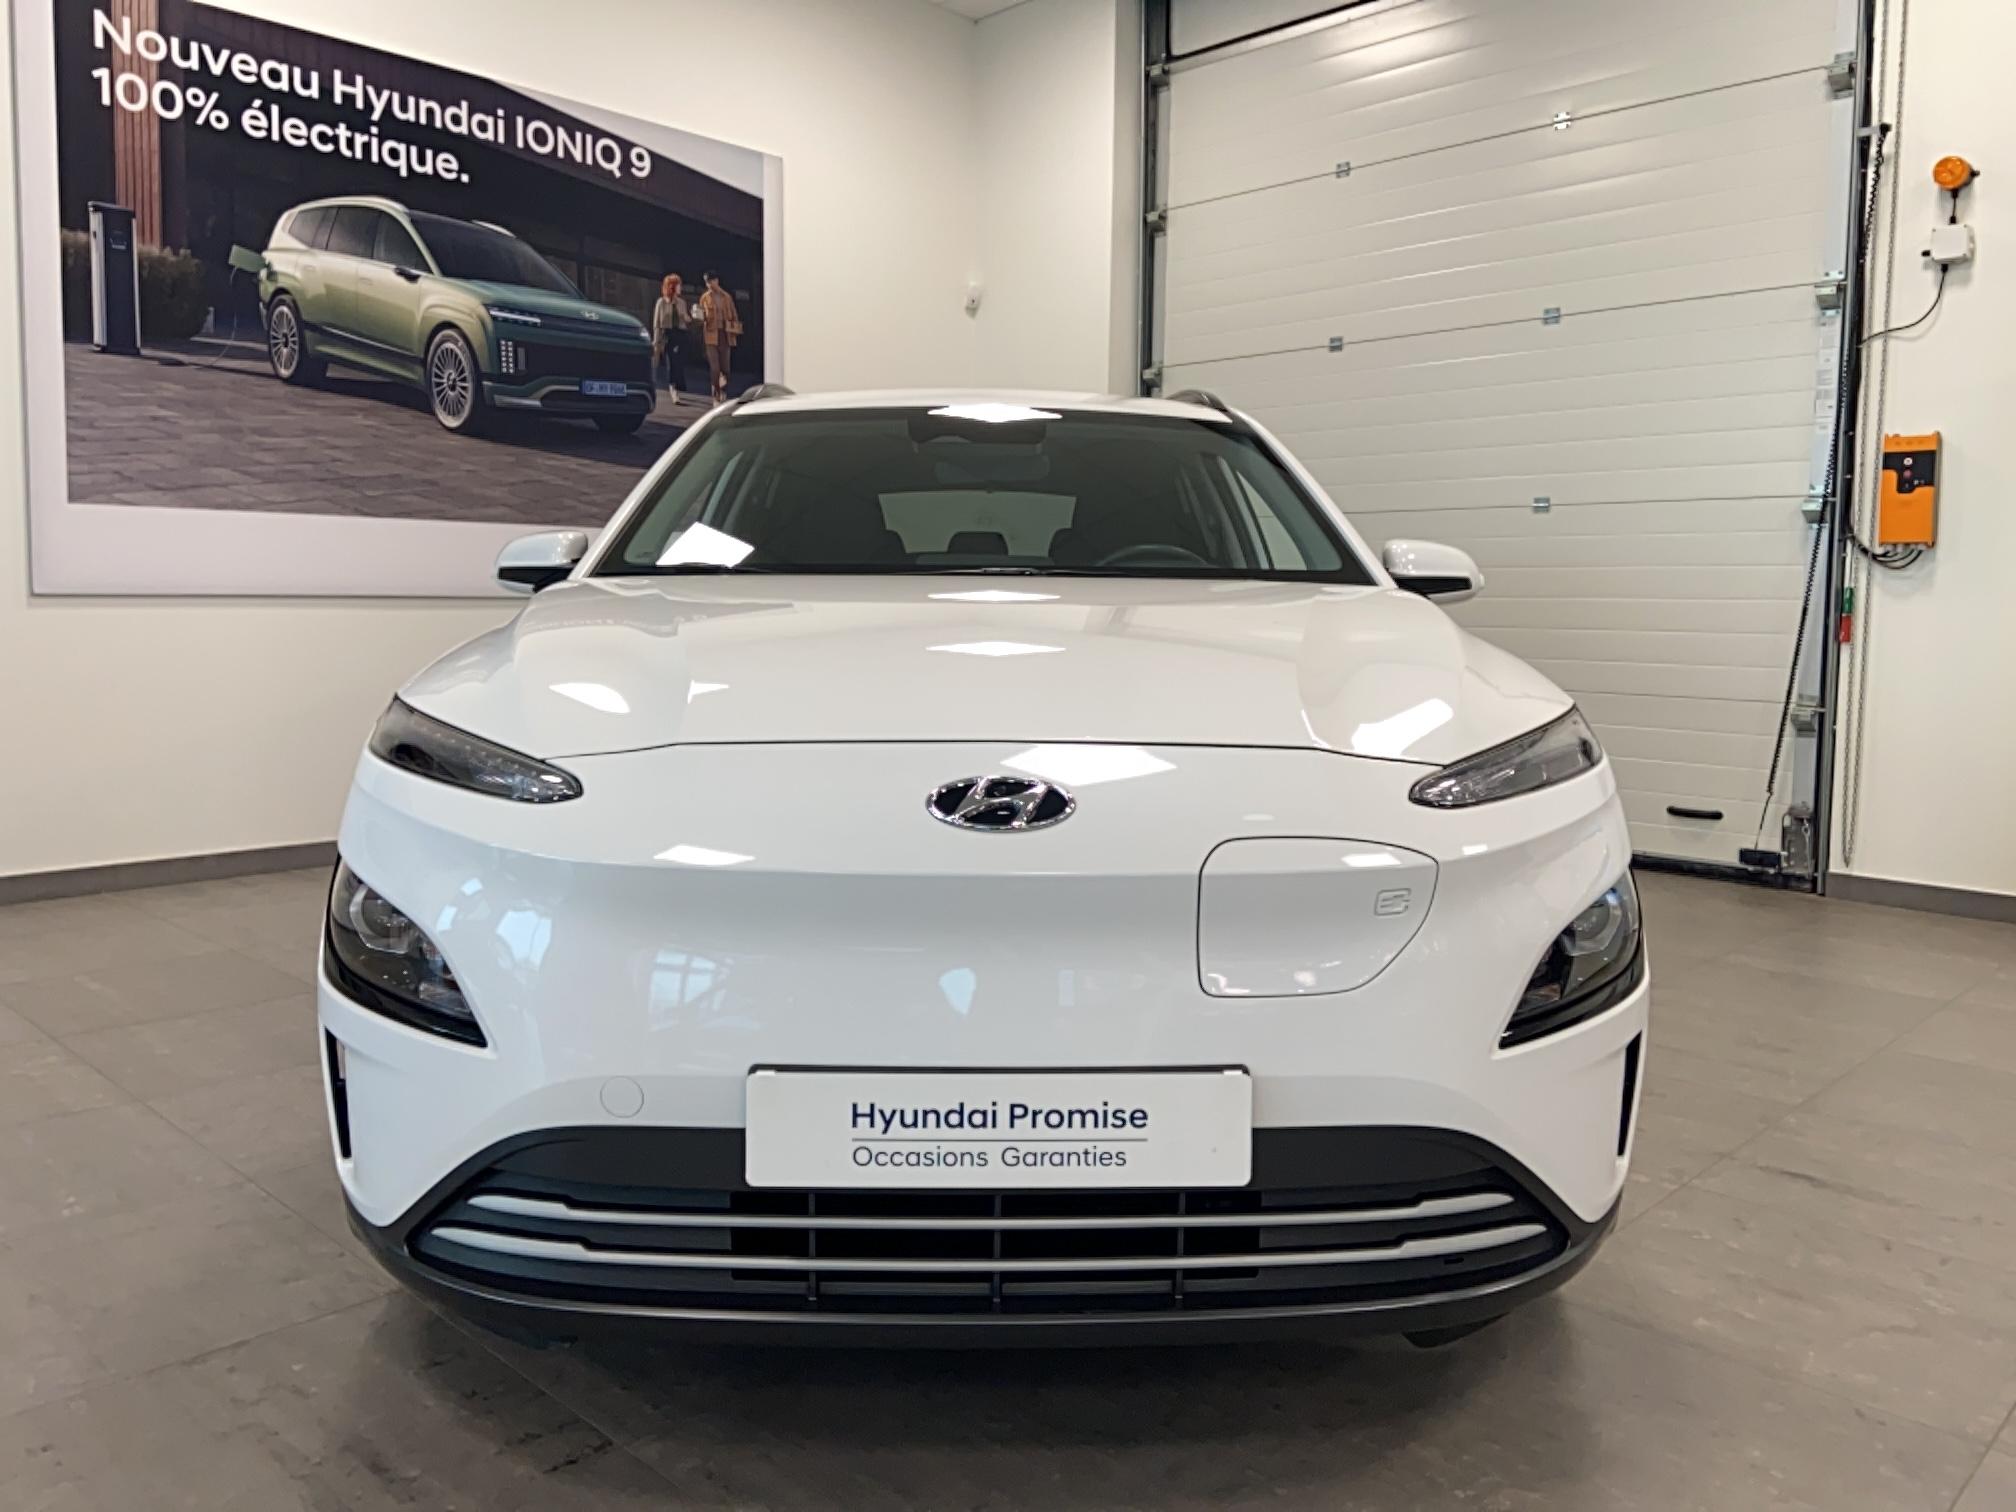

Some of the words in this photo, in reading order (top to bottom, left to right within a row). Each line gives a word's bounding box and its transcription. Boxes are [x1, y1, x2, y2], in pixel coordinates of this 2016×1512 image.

[91, 67, 230, 130] 100%
[241, 99, 470, 184] électrique.
[93, 9, 320, 99] Nouveau
[333, 69, 505, 144] Hyundai
[516, 115, 622, 179] IONIQ
[630, 147, 651, 178] 9
[851, 1101, 998, 1134] Hyundai
[1009, 1101, 1148, 1129] Promise
[852, 1145, 989, 1167] Occasions
[1001, 1145, 1127, 1167] Garanties
